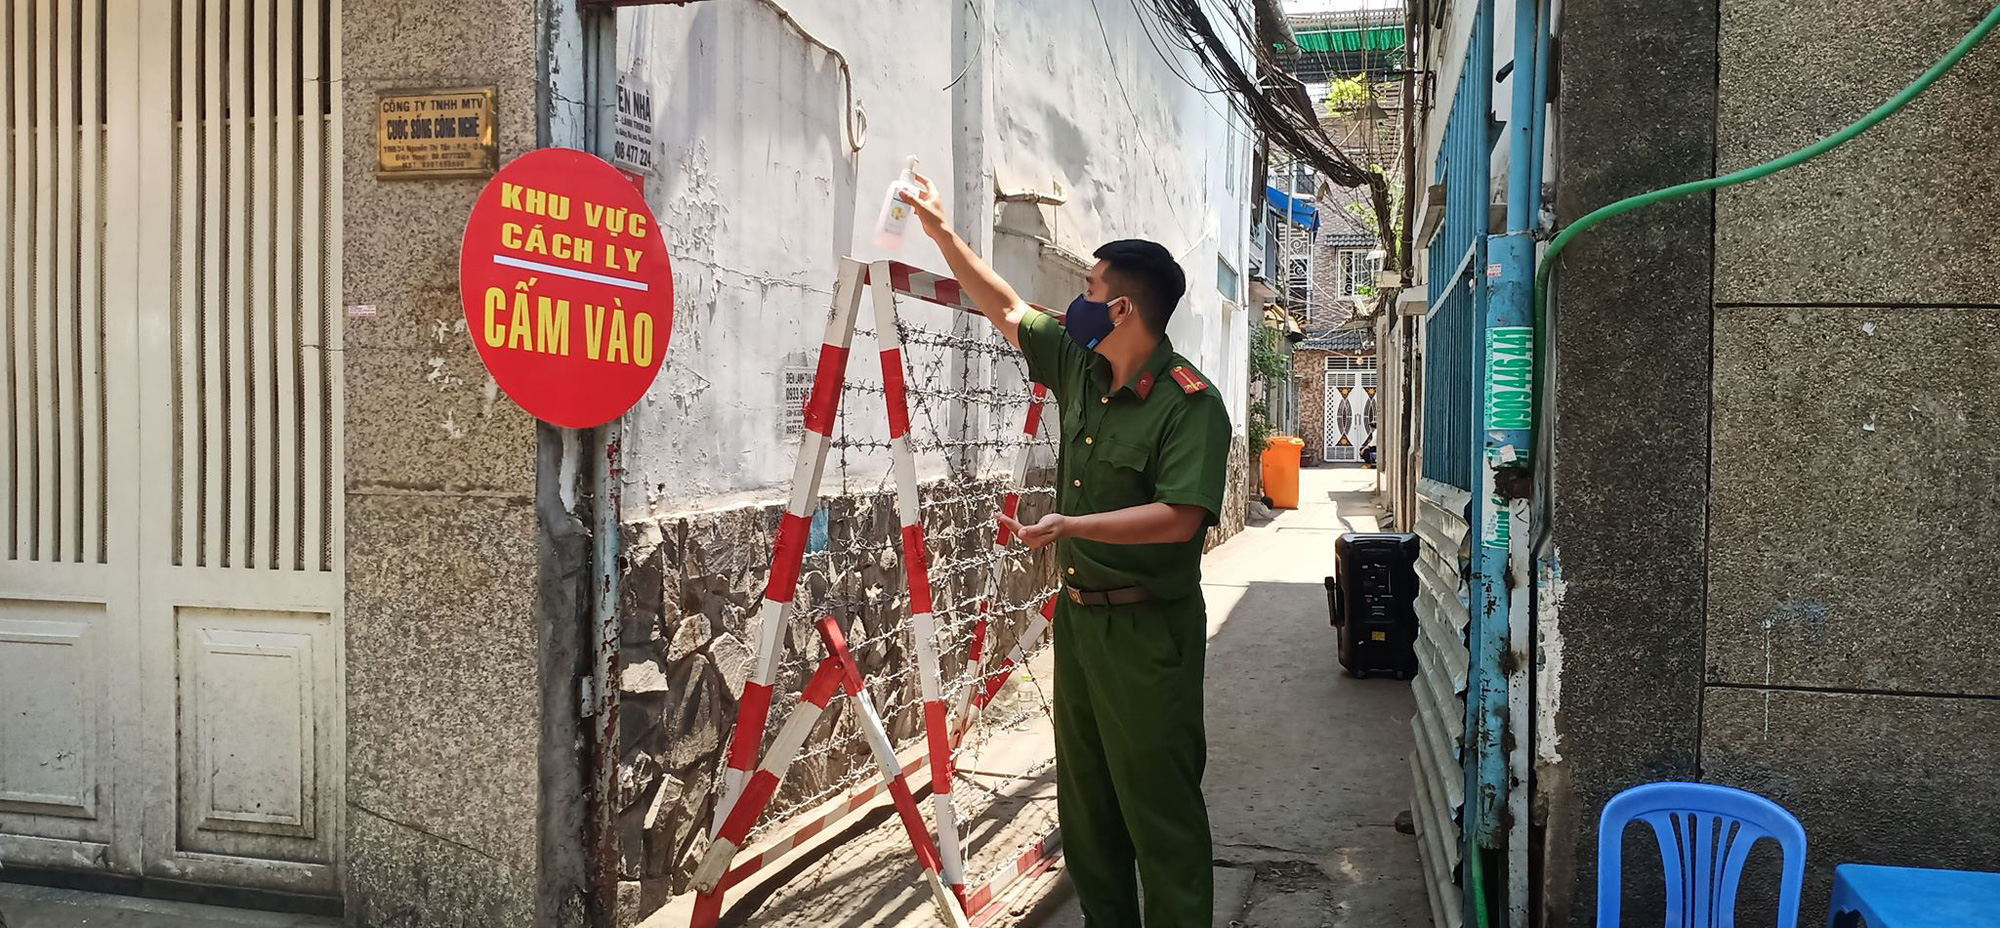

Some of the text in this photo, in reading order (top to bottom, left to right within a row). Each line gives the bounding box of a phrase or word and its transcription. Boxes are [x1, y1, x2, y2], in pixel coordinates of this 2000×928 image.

[383, 98, 483, 113] CÔNG TY TNHH MTV
[633, 89, 651, 122] NHÀ
[387, 115, 408, 143] CUỘC
[411, 113, 432, 139] SỐNG
[434, 114, 456, 139] CÔNG
[626, 144, 638, 163] 477
[640, 148, 651, 168] 224
[501, 182, 647, 238] KHU VỰC
[502, 223, 643, 273] CÁCH LY
[484, 277, 654, 368] CẤM VÀO
